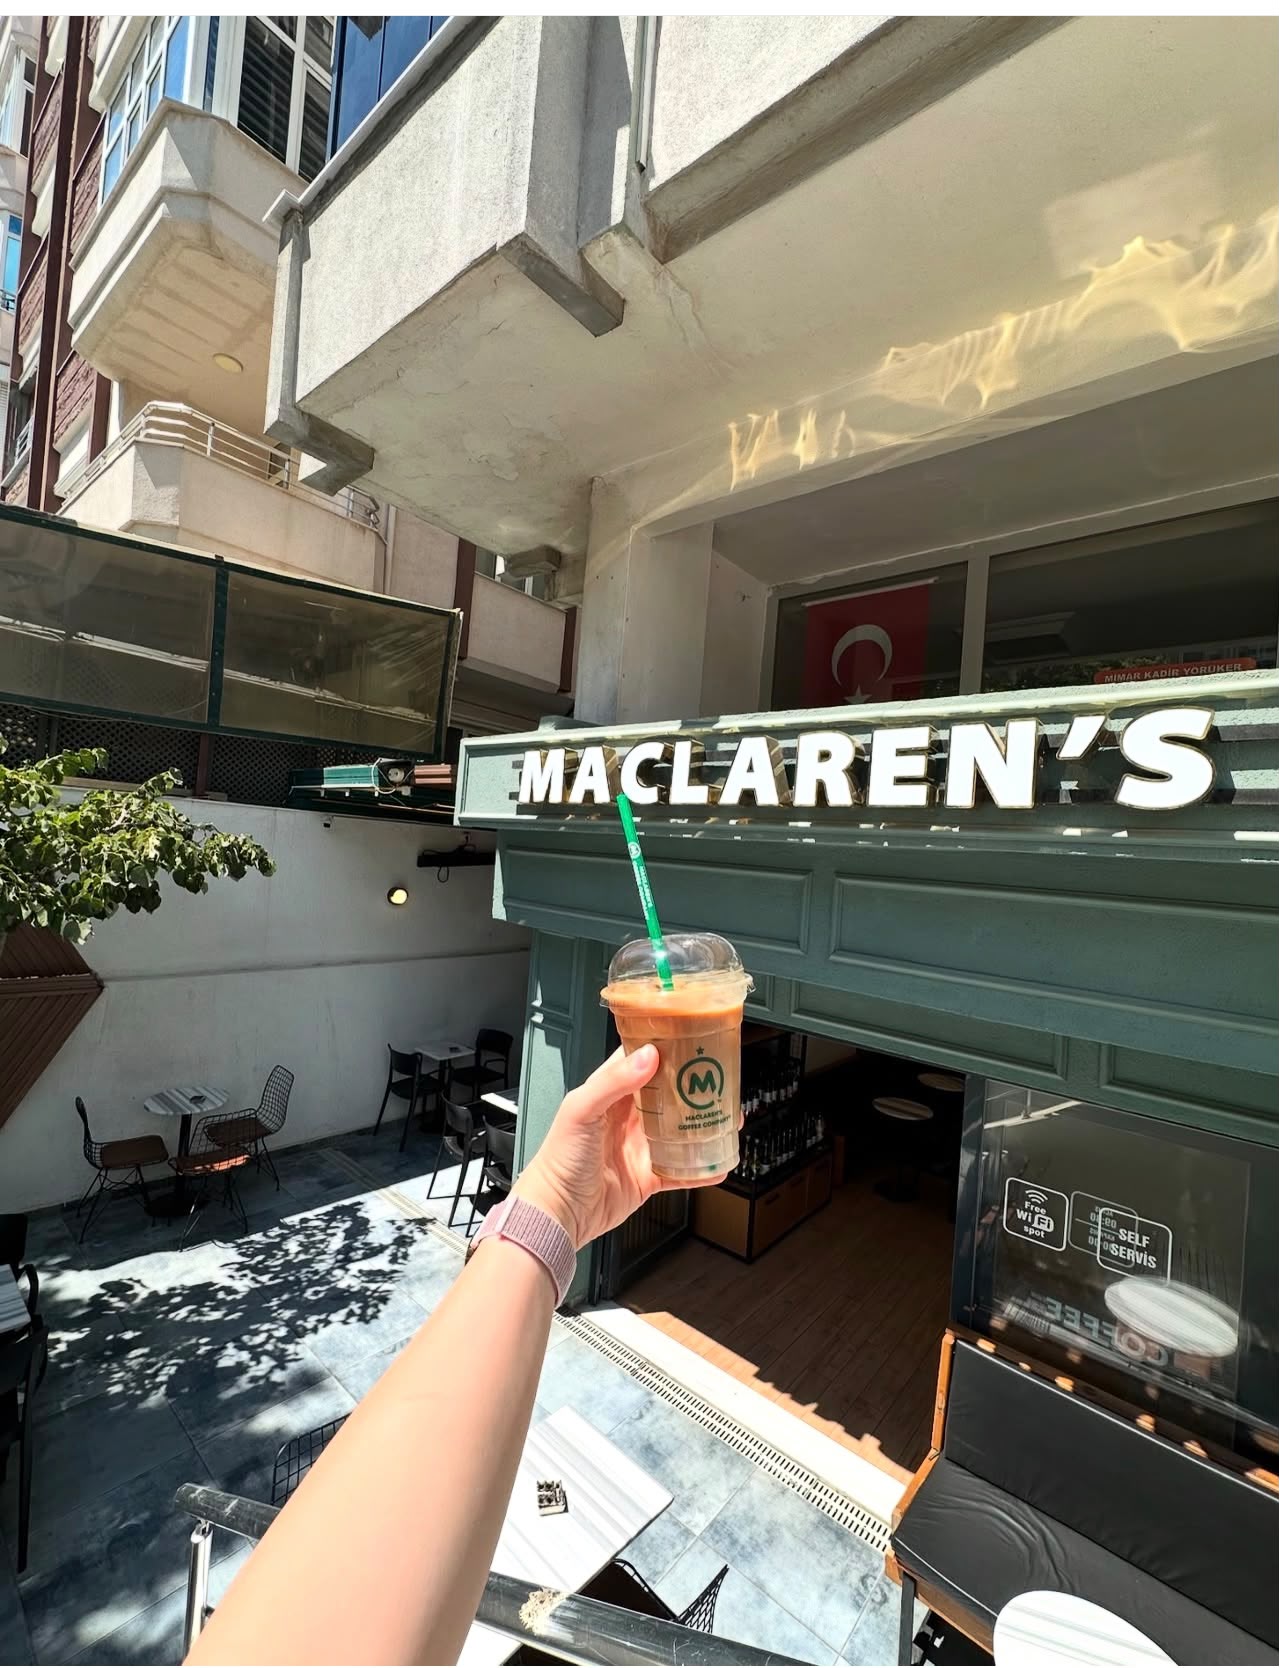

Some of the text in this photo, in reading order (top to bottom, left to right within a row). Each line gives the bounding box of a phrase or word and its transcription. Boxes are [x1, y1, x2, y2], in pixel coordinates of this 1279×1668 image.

[518, 706, 1215, 810] MACLAREN'S
[678, 1123, 701, 1131] COFFEE
[1025, 1201, 1047, 1215] Free
[1023, 1226, 1046, 1238] spot
[1118, 1228, 1150, 1248] SELF
